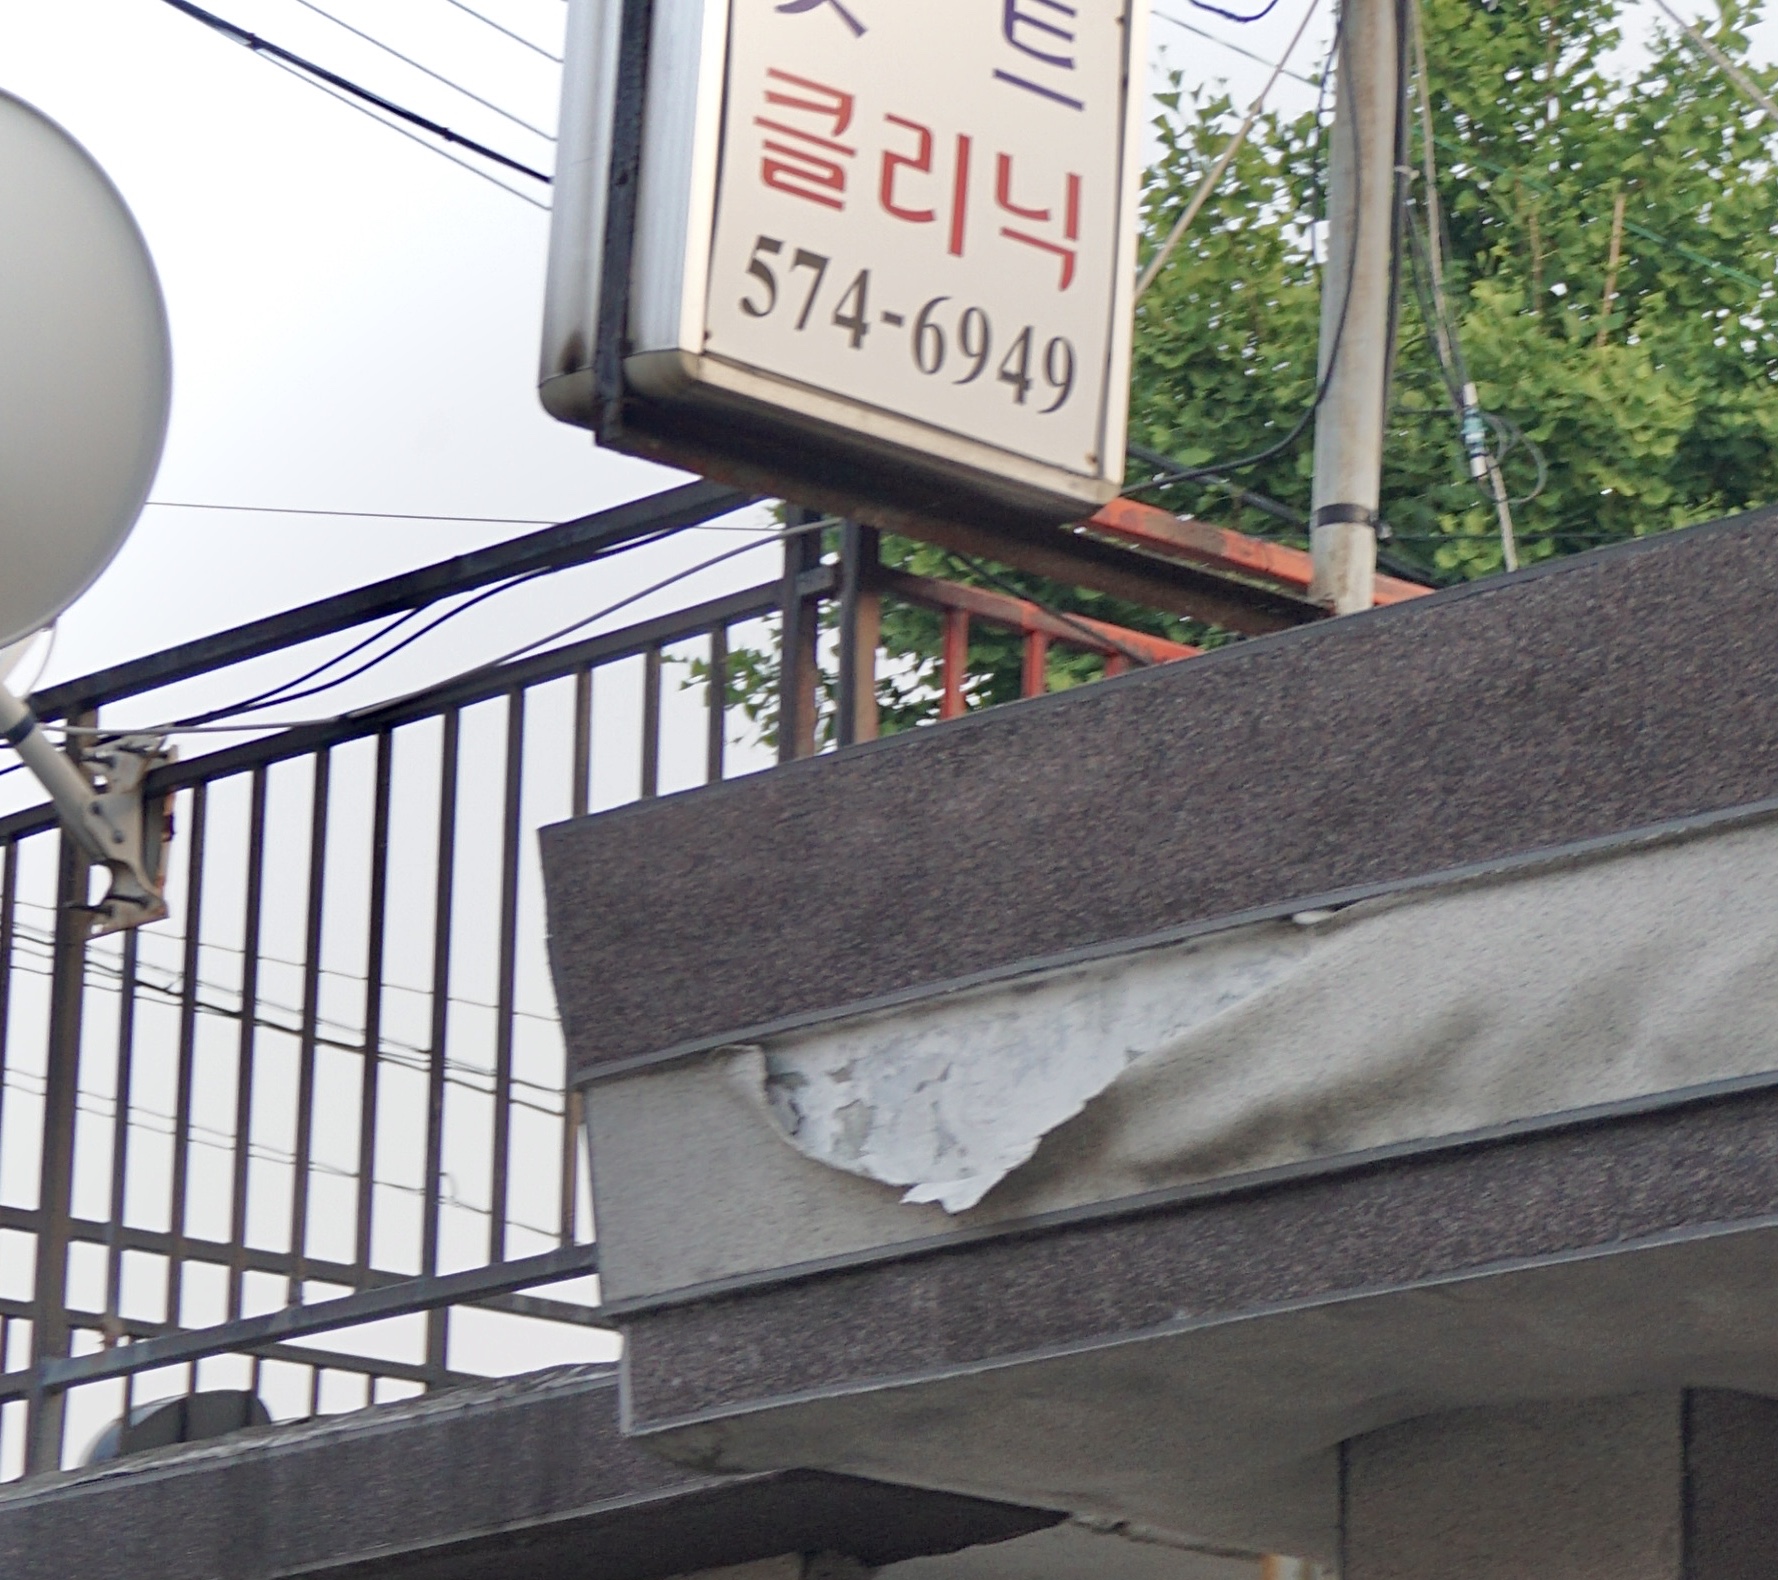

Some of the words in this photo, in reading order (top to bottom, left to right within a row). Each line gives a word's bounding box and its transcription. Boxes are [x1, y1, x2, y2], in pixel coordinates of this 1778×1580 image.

[774, 0, 1085, 111] 트
[753, 67, 1081, 291] 클리닉
[738, 235, 1077, 415] 574-6949
